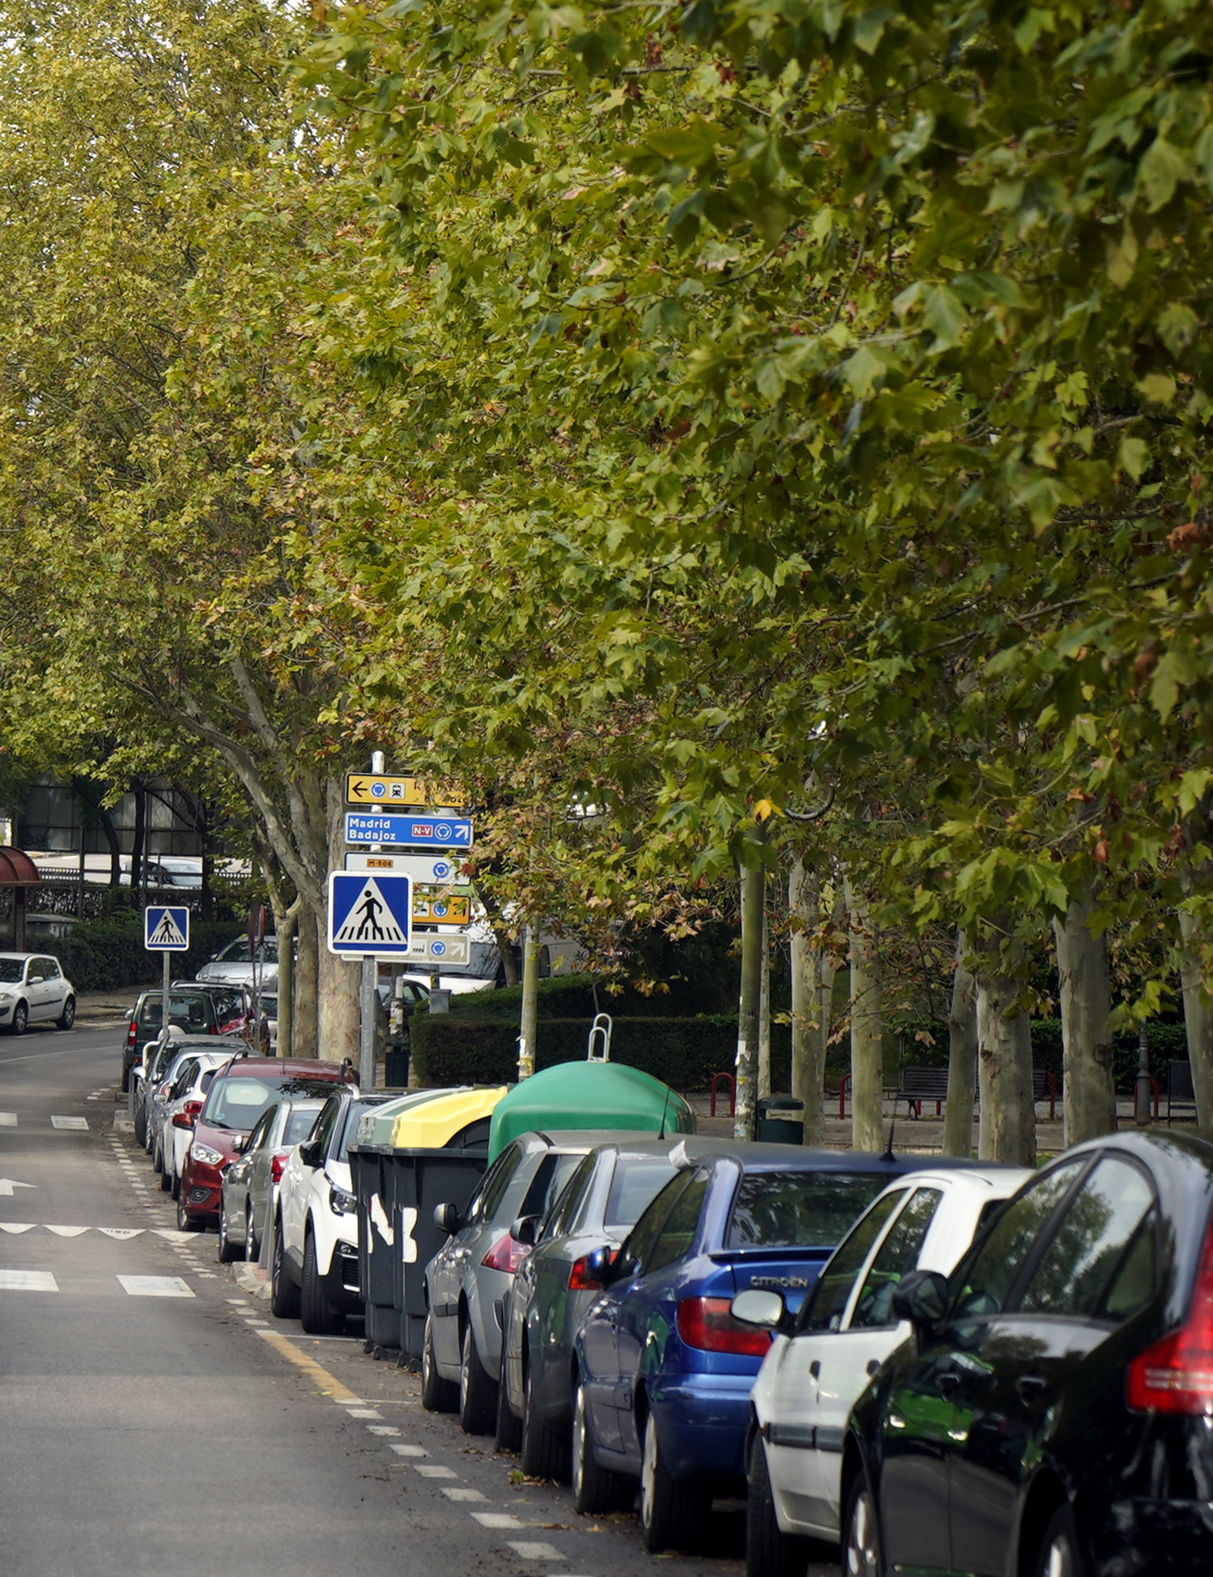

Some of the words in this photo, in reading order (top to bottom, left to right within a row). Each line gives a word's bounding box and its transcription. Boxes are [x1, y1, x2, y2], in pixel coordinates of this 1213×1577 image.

[349, 818, 391, 829] Madrid
[349, 829, 396, 841] Badajoz
[413, 826, 431, 835] N-V
[750, 1275, 809, 1288] CITROËN
